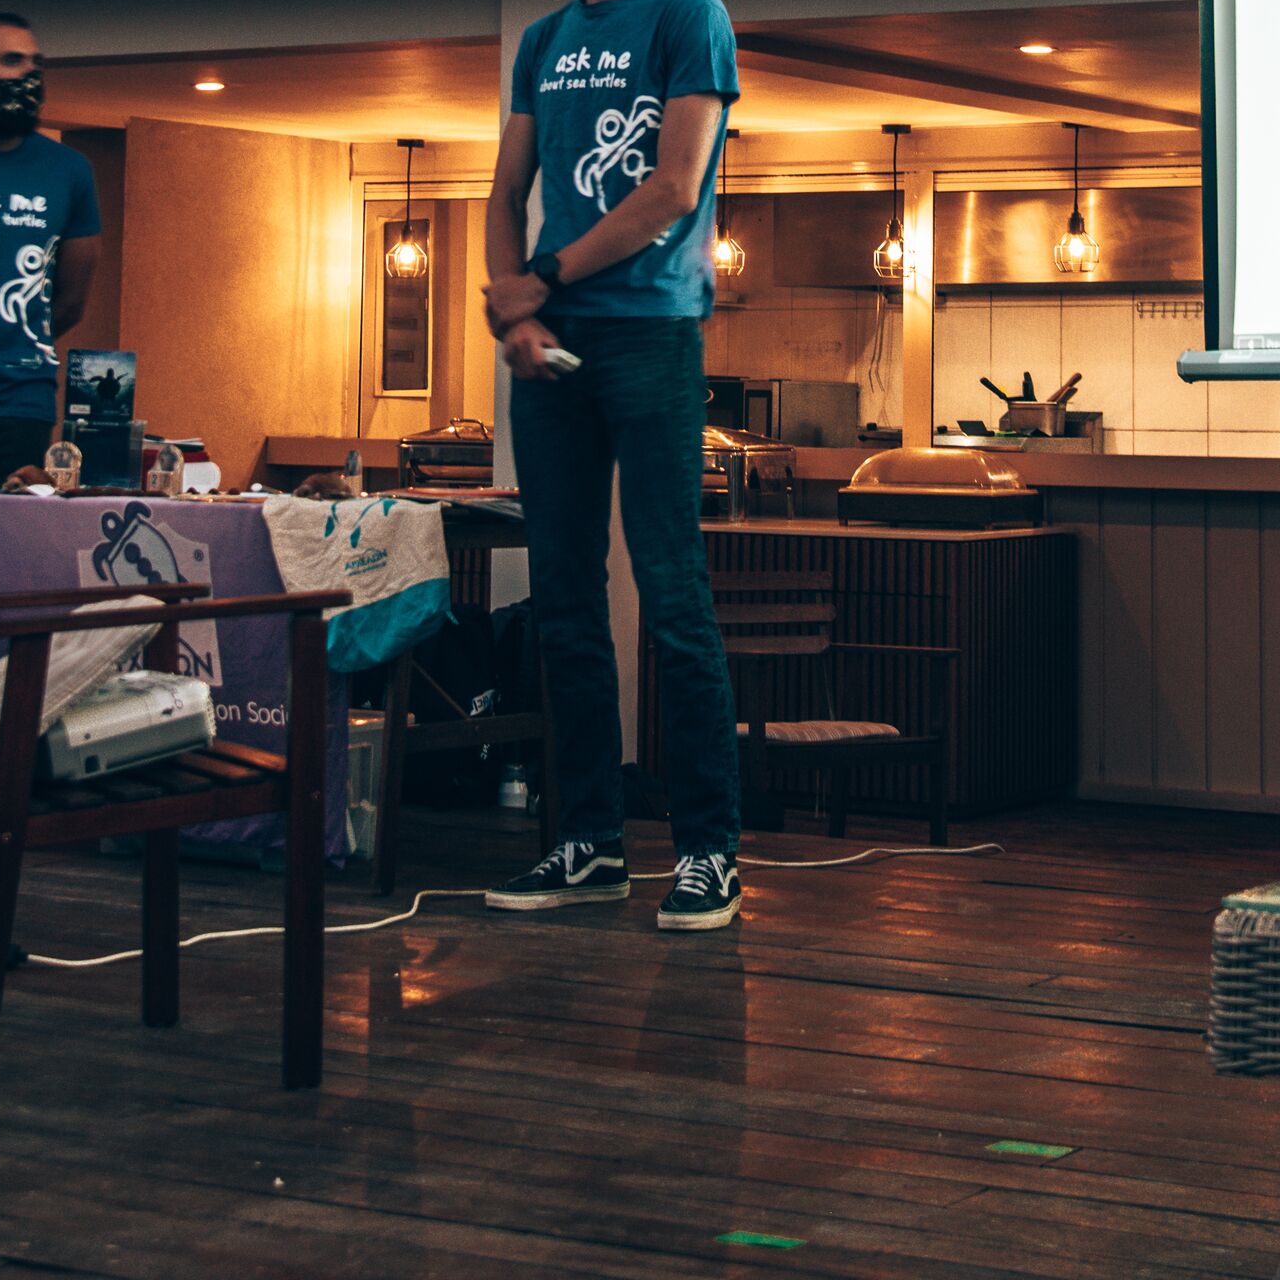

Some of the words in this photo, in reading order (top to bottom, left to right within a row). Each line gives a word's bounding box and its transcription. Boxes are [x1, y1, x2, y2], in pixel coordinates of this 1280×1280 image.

[555, 46, 591, 73] ask
[597, 51, 631, 71] me
[566, 78, 587, 90] sea
[589, 72, 627, 89] turtles
[9, 193, 48, 213] me
[2, 213, 48, 229] turtles
[214, 703, 242, 722] on
[245, 700, 289, 727] Soci
